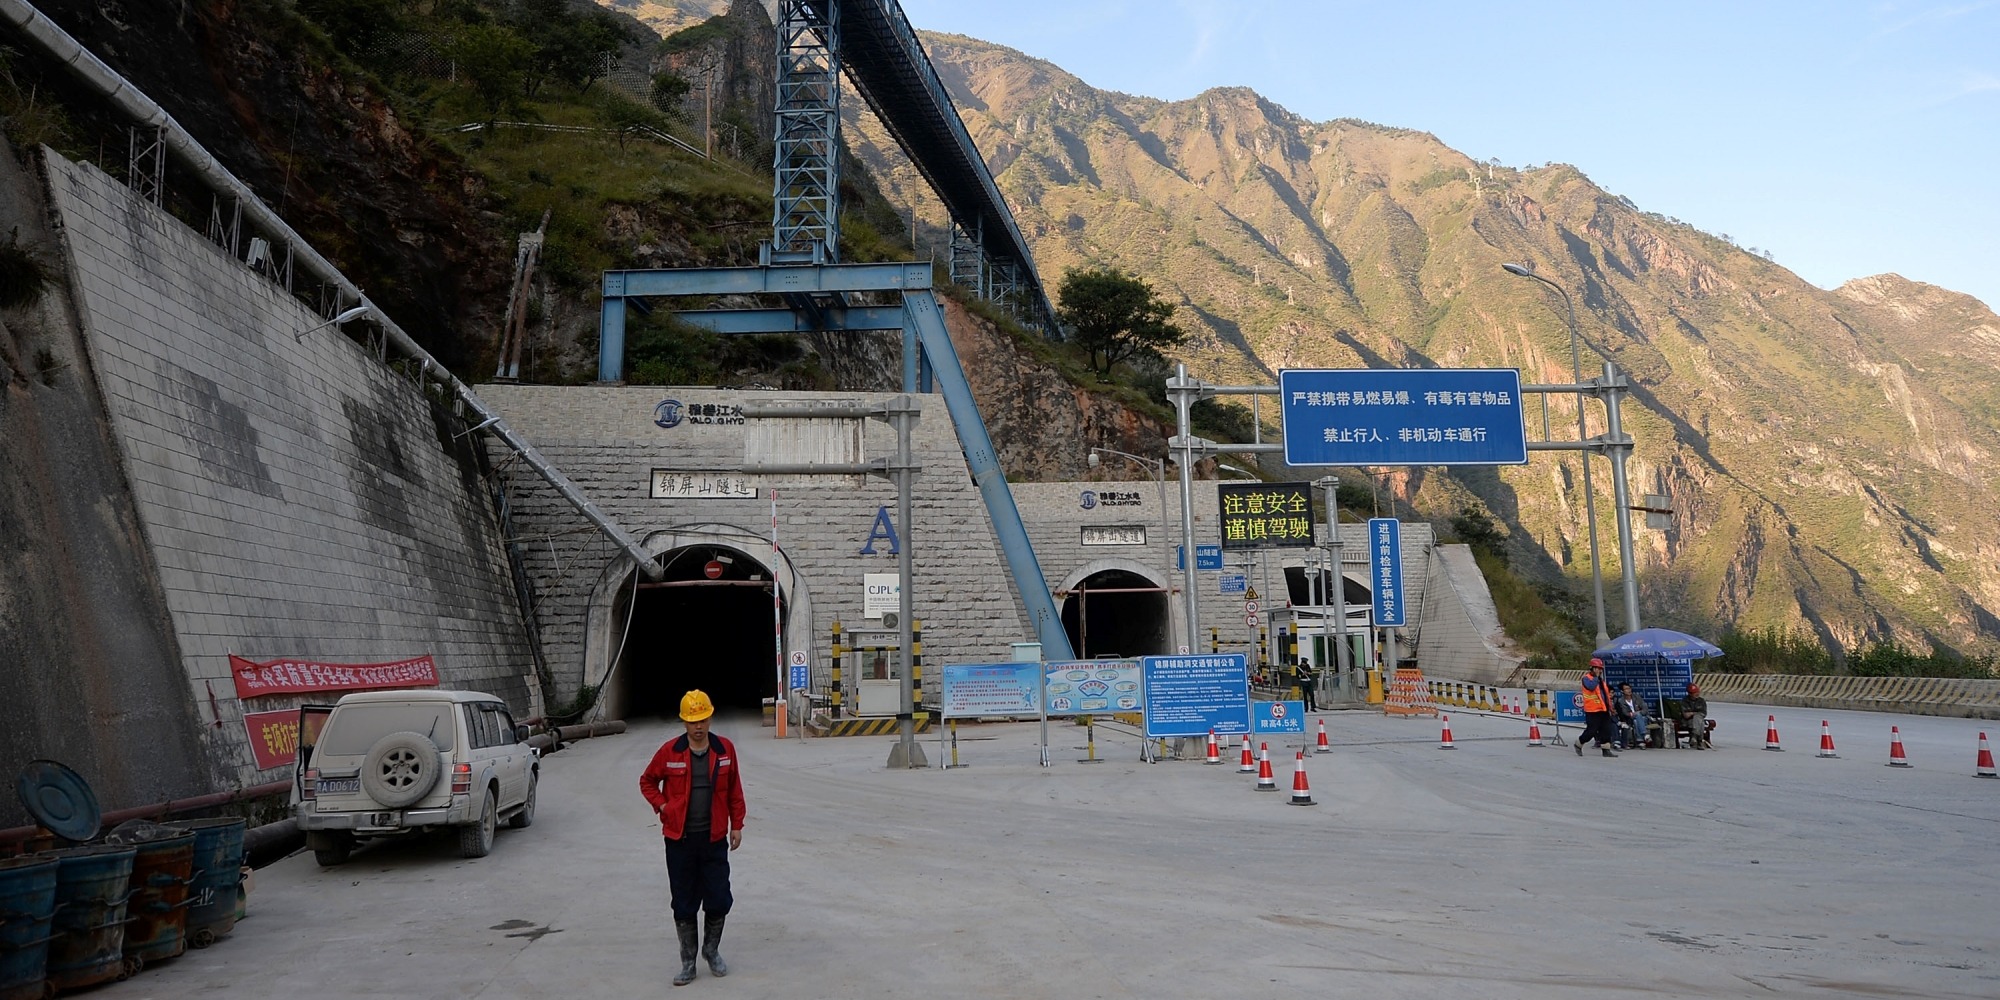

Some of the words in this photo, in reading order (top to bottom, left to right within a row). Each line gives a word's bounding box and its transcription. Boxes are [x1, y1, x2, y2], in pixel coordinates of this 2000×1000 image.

[1292, 391, 1511, 406] 严禁携带易燃易爆、有毒有害物品
[1324, 427, 1487, 443] 禁止行人、非机动车通行
[660, 475, 750, 495] 锦屏山隧道
[1223, 491, 1307, 515] 注意安全
[859, 506, 900, 555] A
[1225, 517, 1311, 540] 谨慎驾驶
[1378, 523, 1395, 622] 进洞前检查车辆安全
[868, 585, 892, 595] CJPL
[1154, 658, 1235, 669] 锦屏辅助洞交通管制公告
[1260, 718, 1298, 728] 限高4.5米
